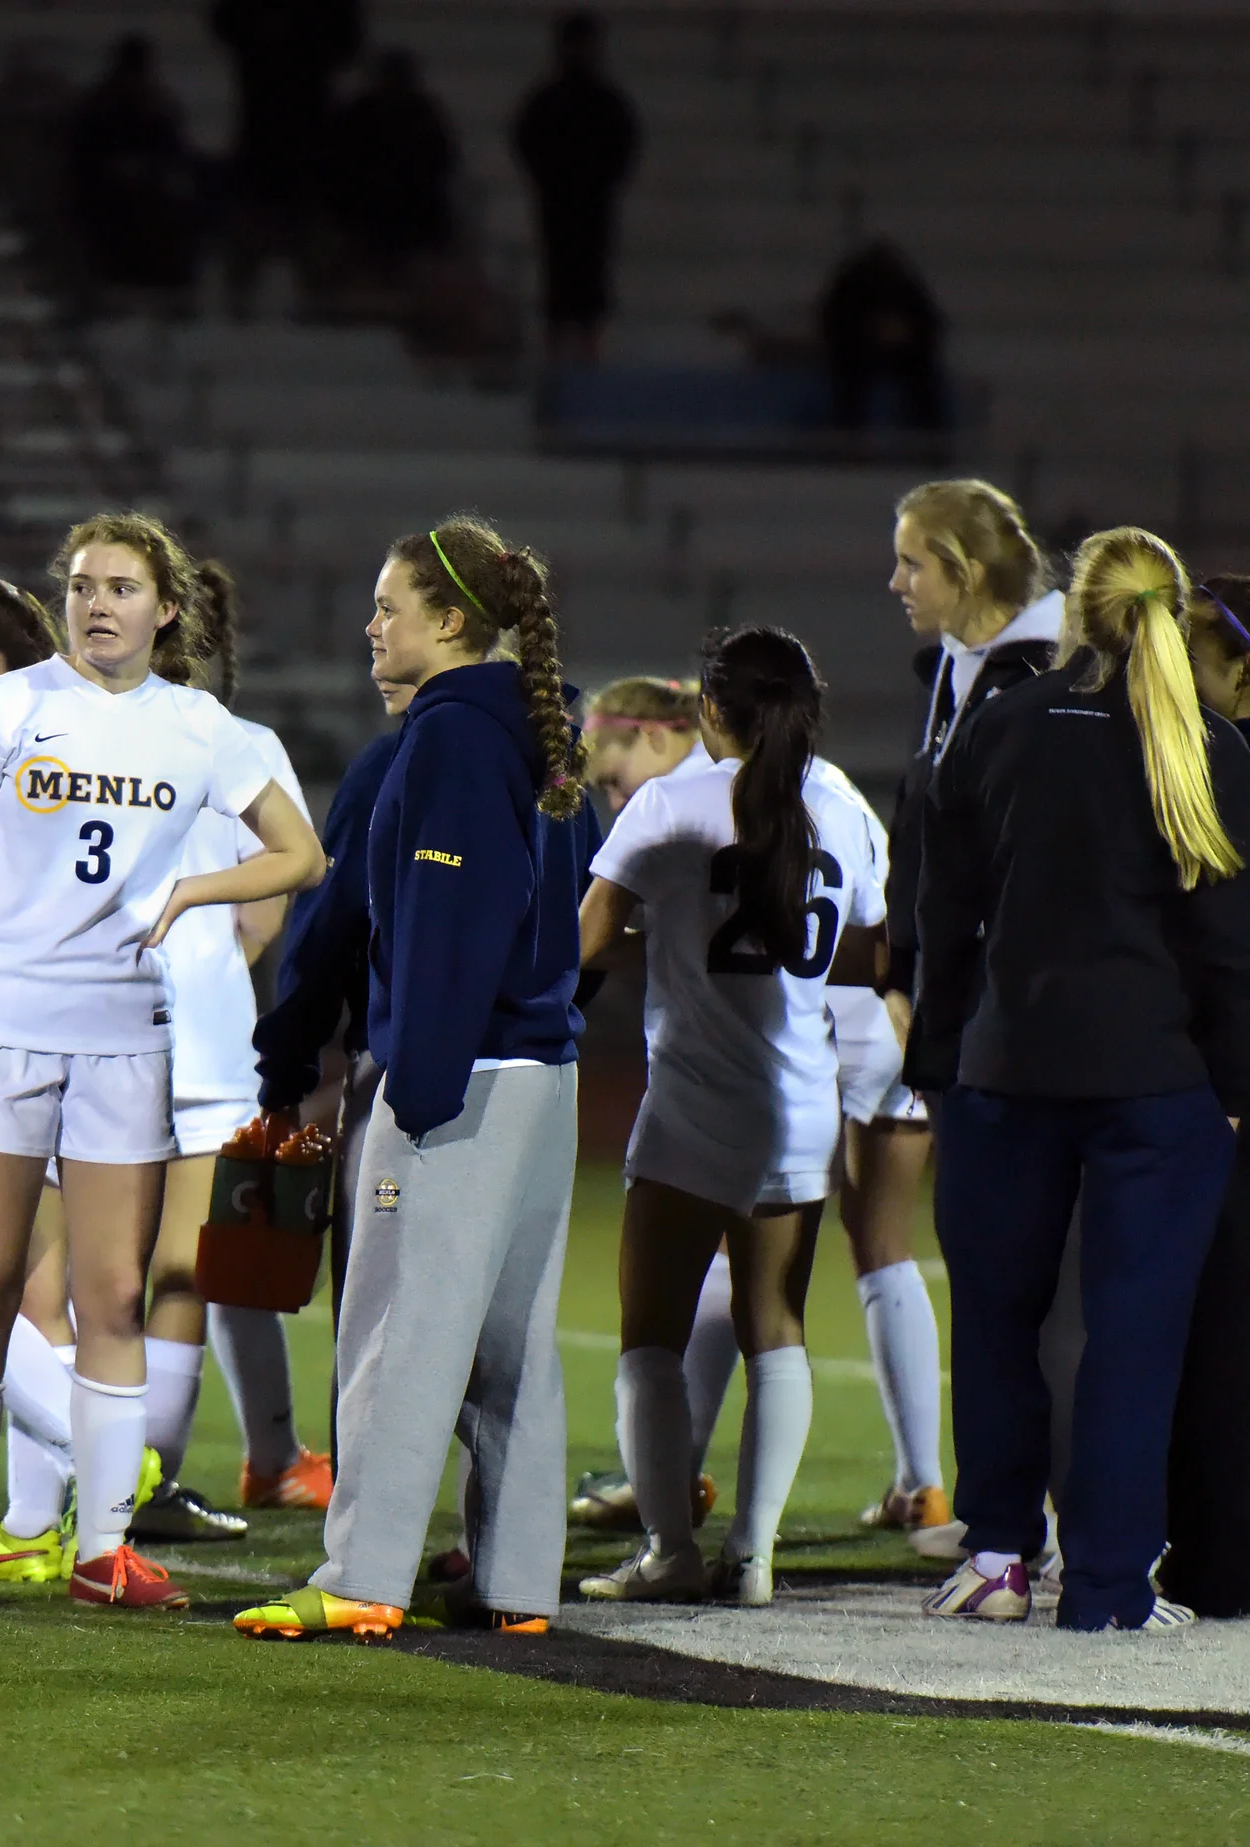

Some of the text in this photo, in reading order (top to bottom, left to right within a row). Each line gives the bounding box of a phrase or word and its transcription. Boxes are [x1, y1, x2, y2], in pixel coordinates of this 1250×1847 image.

[26, 768, 177, 812] MENLO
[74, 819, 115, 885] 3
[414, 849, 463, 867] STABILE
[706, 843, 844, 979] 26
